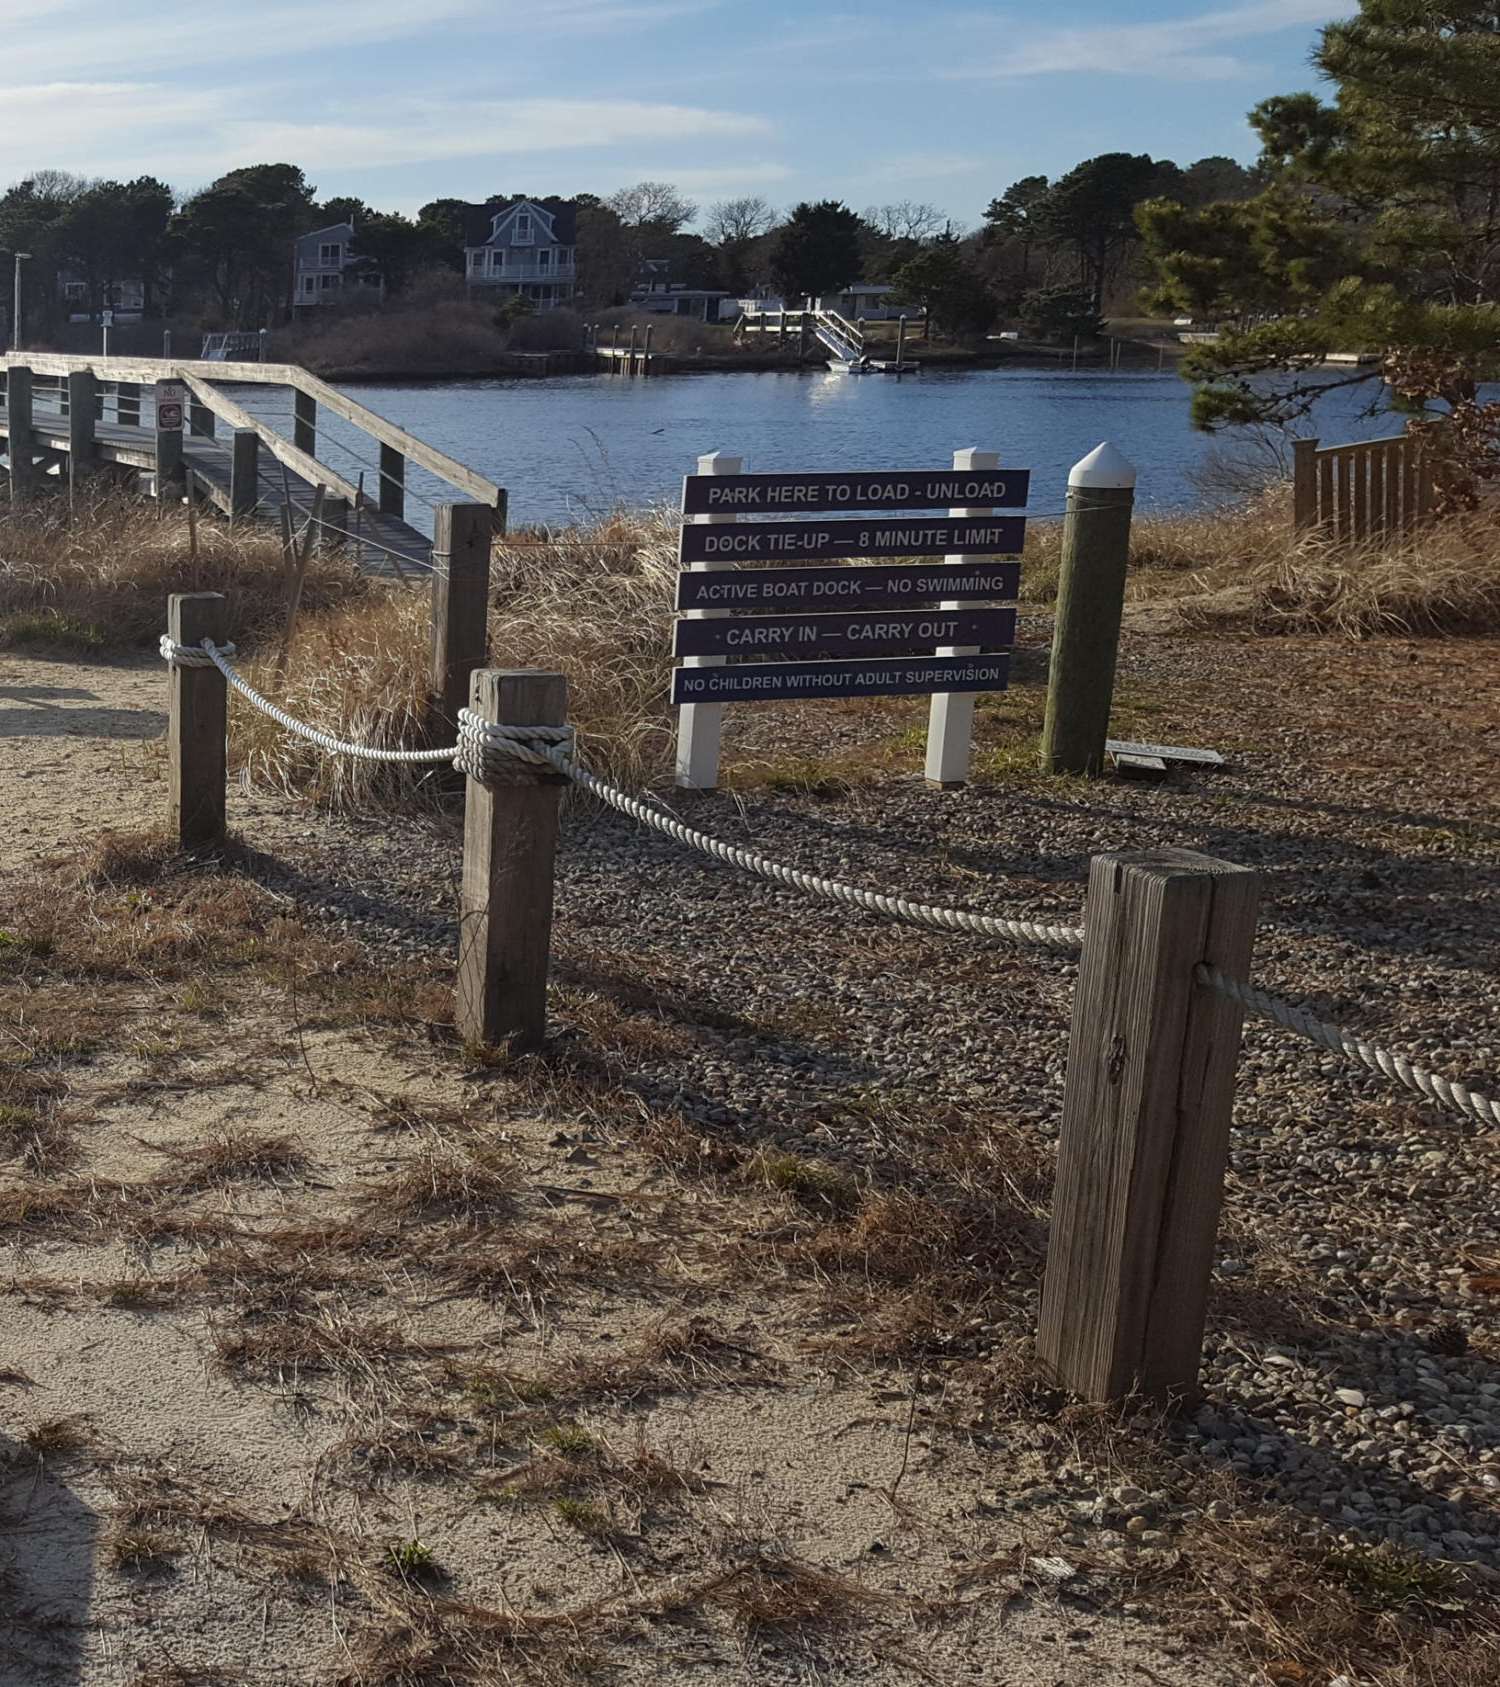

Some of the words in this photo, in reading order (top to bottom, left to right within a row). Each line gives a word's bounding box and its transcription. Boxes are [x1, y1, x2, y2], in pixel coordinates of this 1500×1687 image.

[709, 486, 764, 504] PARK
[767, 486, 819, 502] HERE
[826, 484, 850, 500] TO
[856, 484, 909, 500] LOAD
[927, 482, 1006, 499] UNLOAD
[705, 535, 761, 552] DOCK
[767, 533, 829, 550] TIE-UP
[859, 532, 869, 546] 8
[875, 530, 948, 546] MINUTE
[953, 528, 1003, 545] LIMIT
[696, 583, 757, 600] ACTIVE
[762, 582, 809, 598] BOAT
[813, 581, 861, 596] DOCK
[887, 579, 912, 593] NO
[916, 576, 1003, 592] SWIMMING
[726, 627, 794, 645] CARRY
[799, 626, 817, 642] IN
[847, 623, 914, 640] CARRY
[918, 622, 958, 637] OUT
[683, 679, 705, 692] NO
[709, 675, 782, 690] CHILDREN
[786, 673, 850, 688] WITHOUT
[855, 672, 902, 686] ADULT
[905, 668, 999, 683] SUPERVISION
